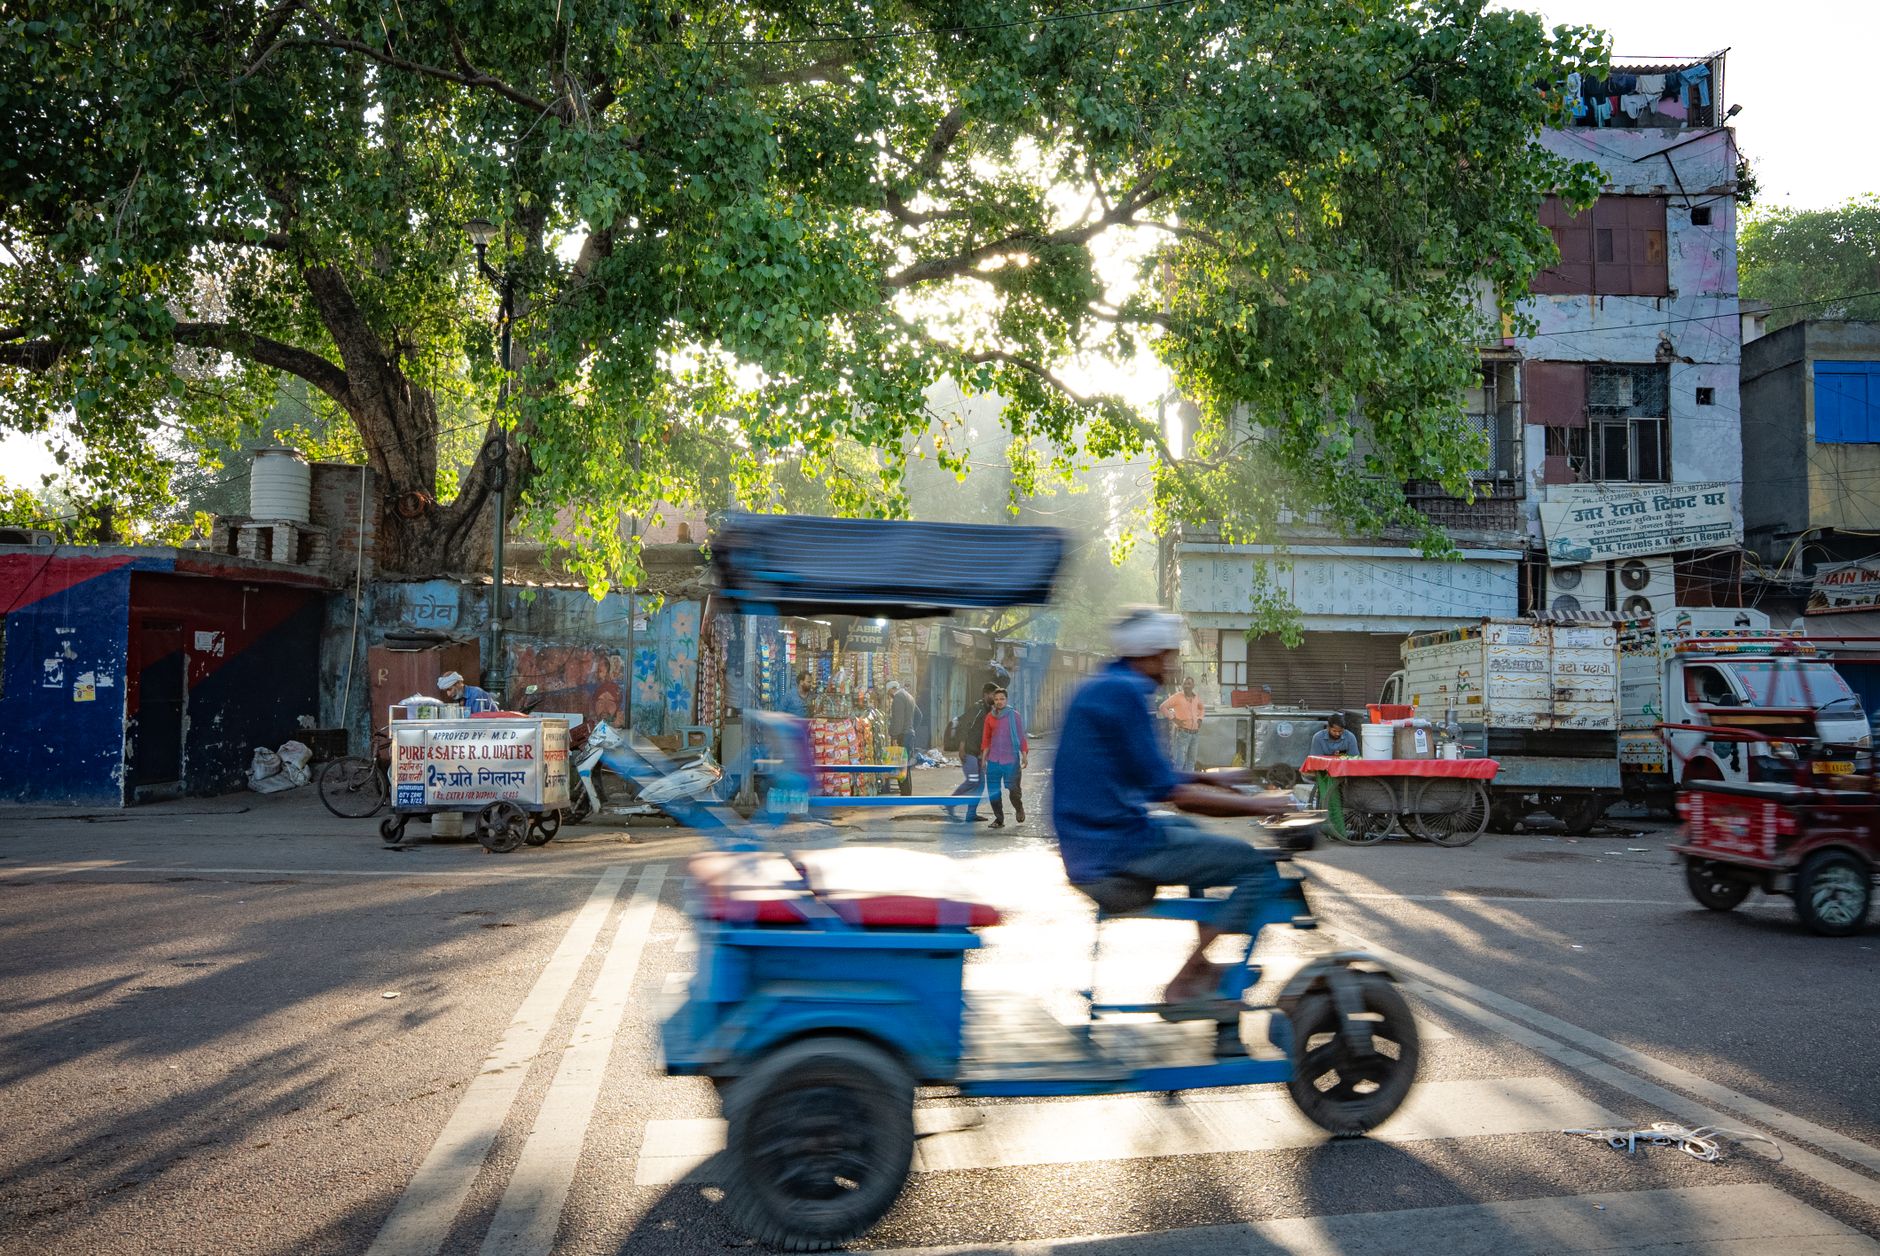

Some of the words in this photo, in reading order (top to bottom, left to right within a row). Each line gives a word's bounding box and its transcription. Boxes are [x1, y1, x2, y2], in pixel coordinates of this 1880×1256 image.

[1606, 497, 1646, 517] रेलवे
[1652, 491, 1696, 512] टिकट
[1702, 491, 1726, 507] घर
[1616, 538, 1652, 550] Travels
[1654, 537, 1660, 545] &
[848, 624, 882, 634] KABIR
[846, 634, 883, 644] STORE
[378, 668, 389, 686] R
[433, 732, 469, 741] APPROVED
[471, 731, 487, 740] BY:
[398, 745, 425, 761] PURE
[426, 746, 434, 760] &
[435, 745, 466, 760] SAFE
[493, 744, 535, 760] WATER
[477, 766, 527, 790] गिलास
[445, 791, 464, 800] EXTRA
